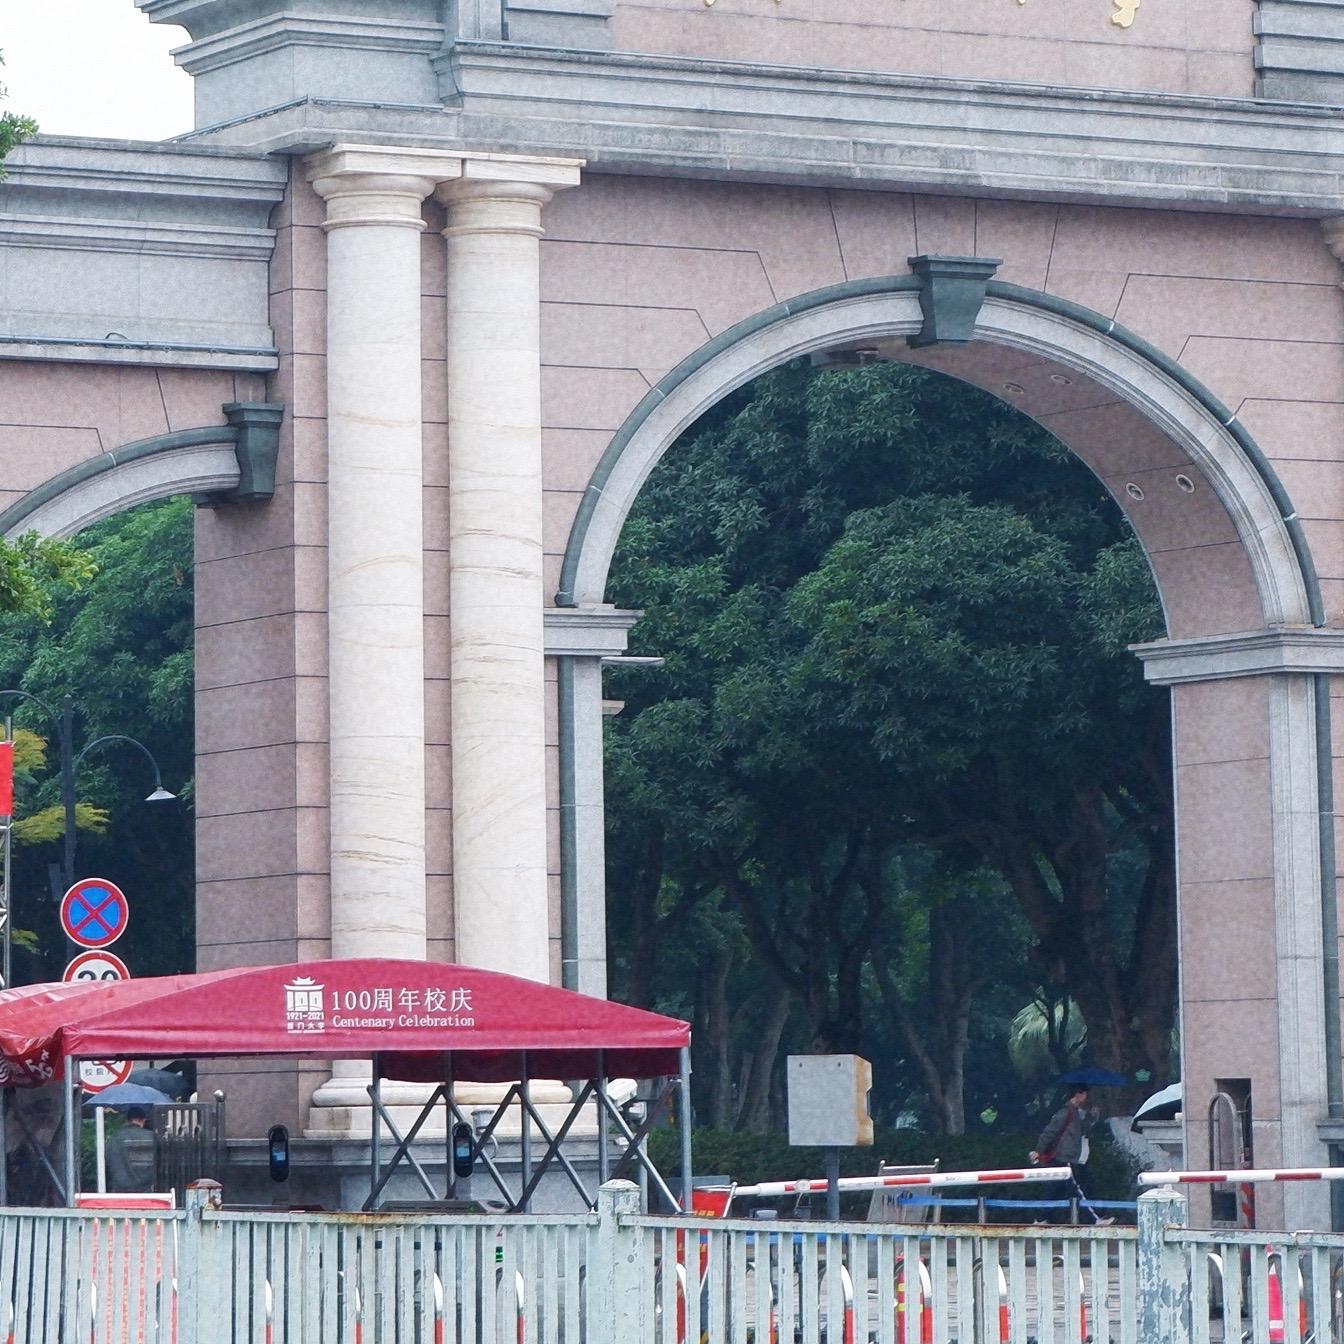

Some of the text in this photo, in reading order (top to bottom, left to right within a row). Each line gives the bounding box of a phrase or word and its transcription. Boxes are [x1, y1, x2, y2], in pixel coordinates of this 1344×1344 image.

[332, 987, 473, 1012] 100周年校庆
[287, 1012, 325, 1020] 1921-2021
[333, 1015, 475, 1029] Centenary Celebration
